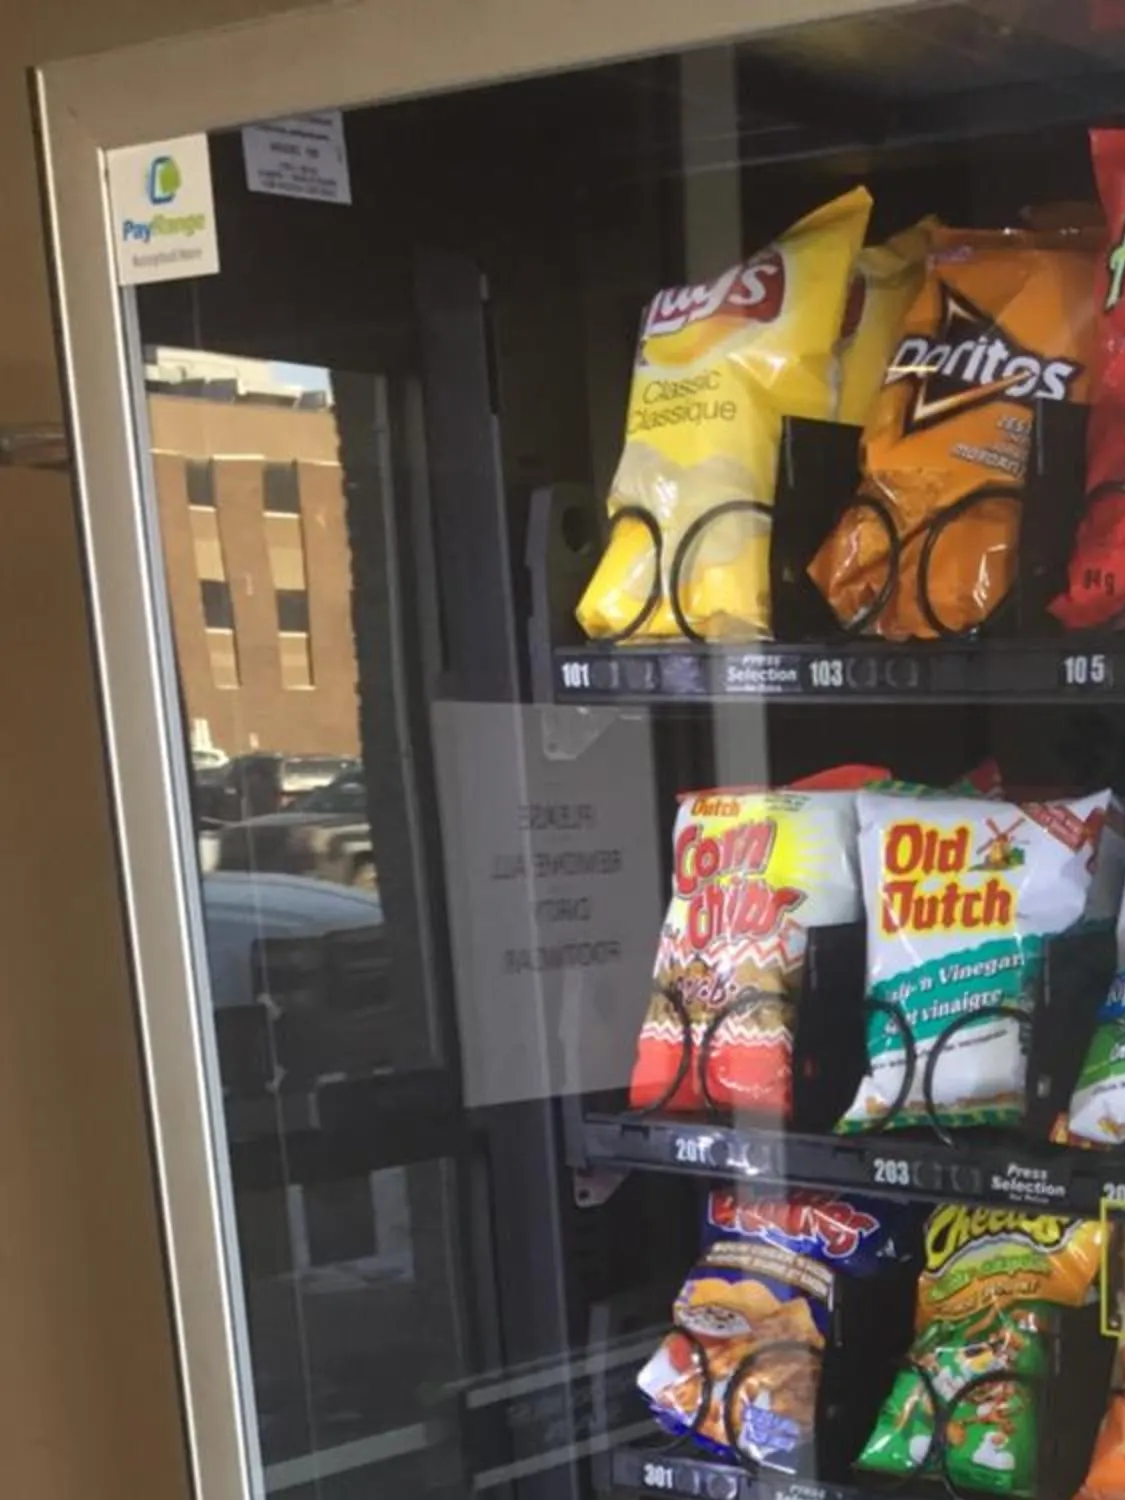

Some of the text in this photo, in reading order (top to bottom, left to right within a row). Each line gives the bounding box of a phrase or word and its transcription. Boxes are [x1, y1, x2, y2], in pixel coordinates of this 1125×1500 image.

[884, 337, 1077, 401] Doritos
[642, 369, 723, 404] Classic
[561, 661, 590, 688] 101
[726, 665, 797, 683] Selection
[809, 658, 844, 688] 103
[1064, 655, 1106, 684] 105
[884, 822, 970, 876] Old
[881, 878, 1012, 934] Dutch
[937, 953, 1025, 989] Vinegar
[874, 1159, 911, 1185] 203
[1006, 1163, 1049, 1179] Press
[991, 1176, 1066, 1197] Selection
[644, 1463, 673, 1489] 301
